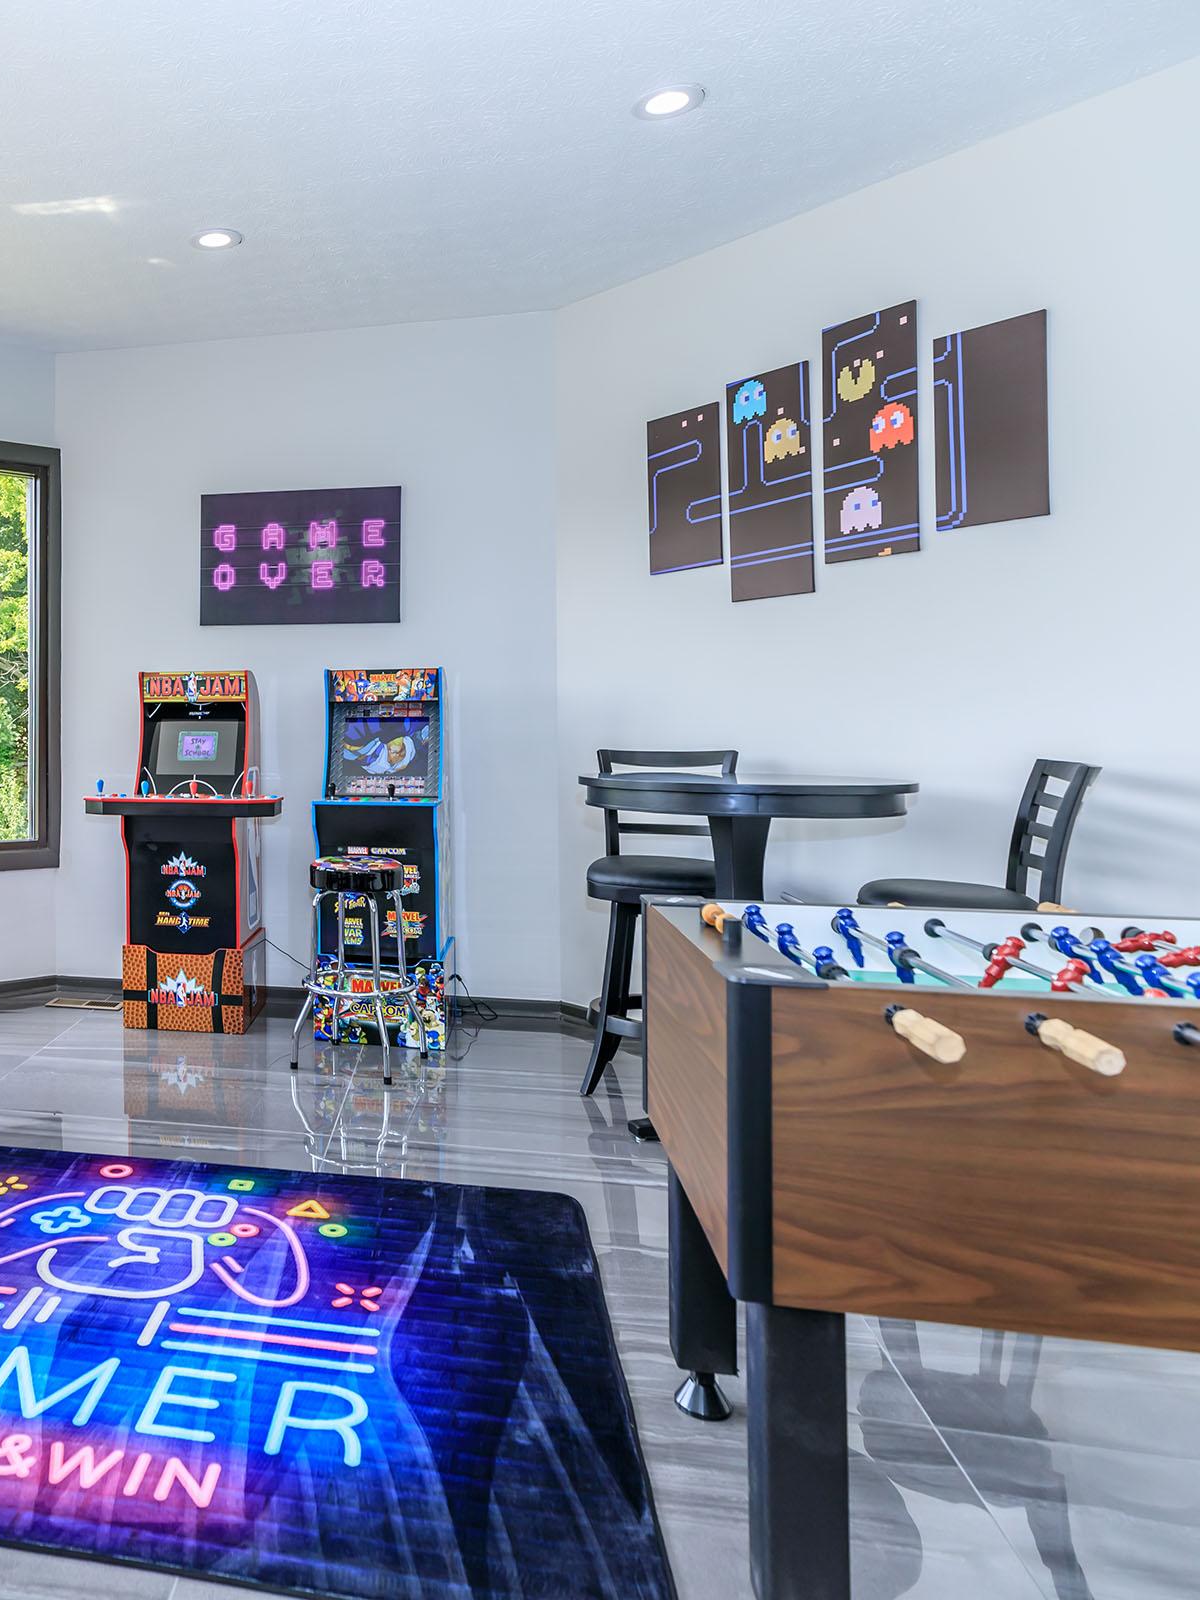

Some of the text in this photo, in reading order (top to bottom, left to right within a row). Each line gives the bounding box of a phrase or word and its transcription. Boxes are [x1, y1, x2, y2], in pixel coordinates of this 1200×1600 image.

[214, 519, 385, 551] GAME
[213, 560, 385, 590] OVER
[150, 677, 240, 696] NBA JAM
[370, 847, 407, 856] CAPCOM
[162, 864, 205, 877] NBA JAM
[156, 916, 210, 926] HANG TIME
[345, 917, 363, 926] ARVEL
[387, 911, 419, 922] MRVEL
[150, 988, 215, 1007] NBA JAM
